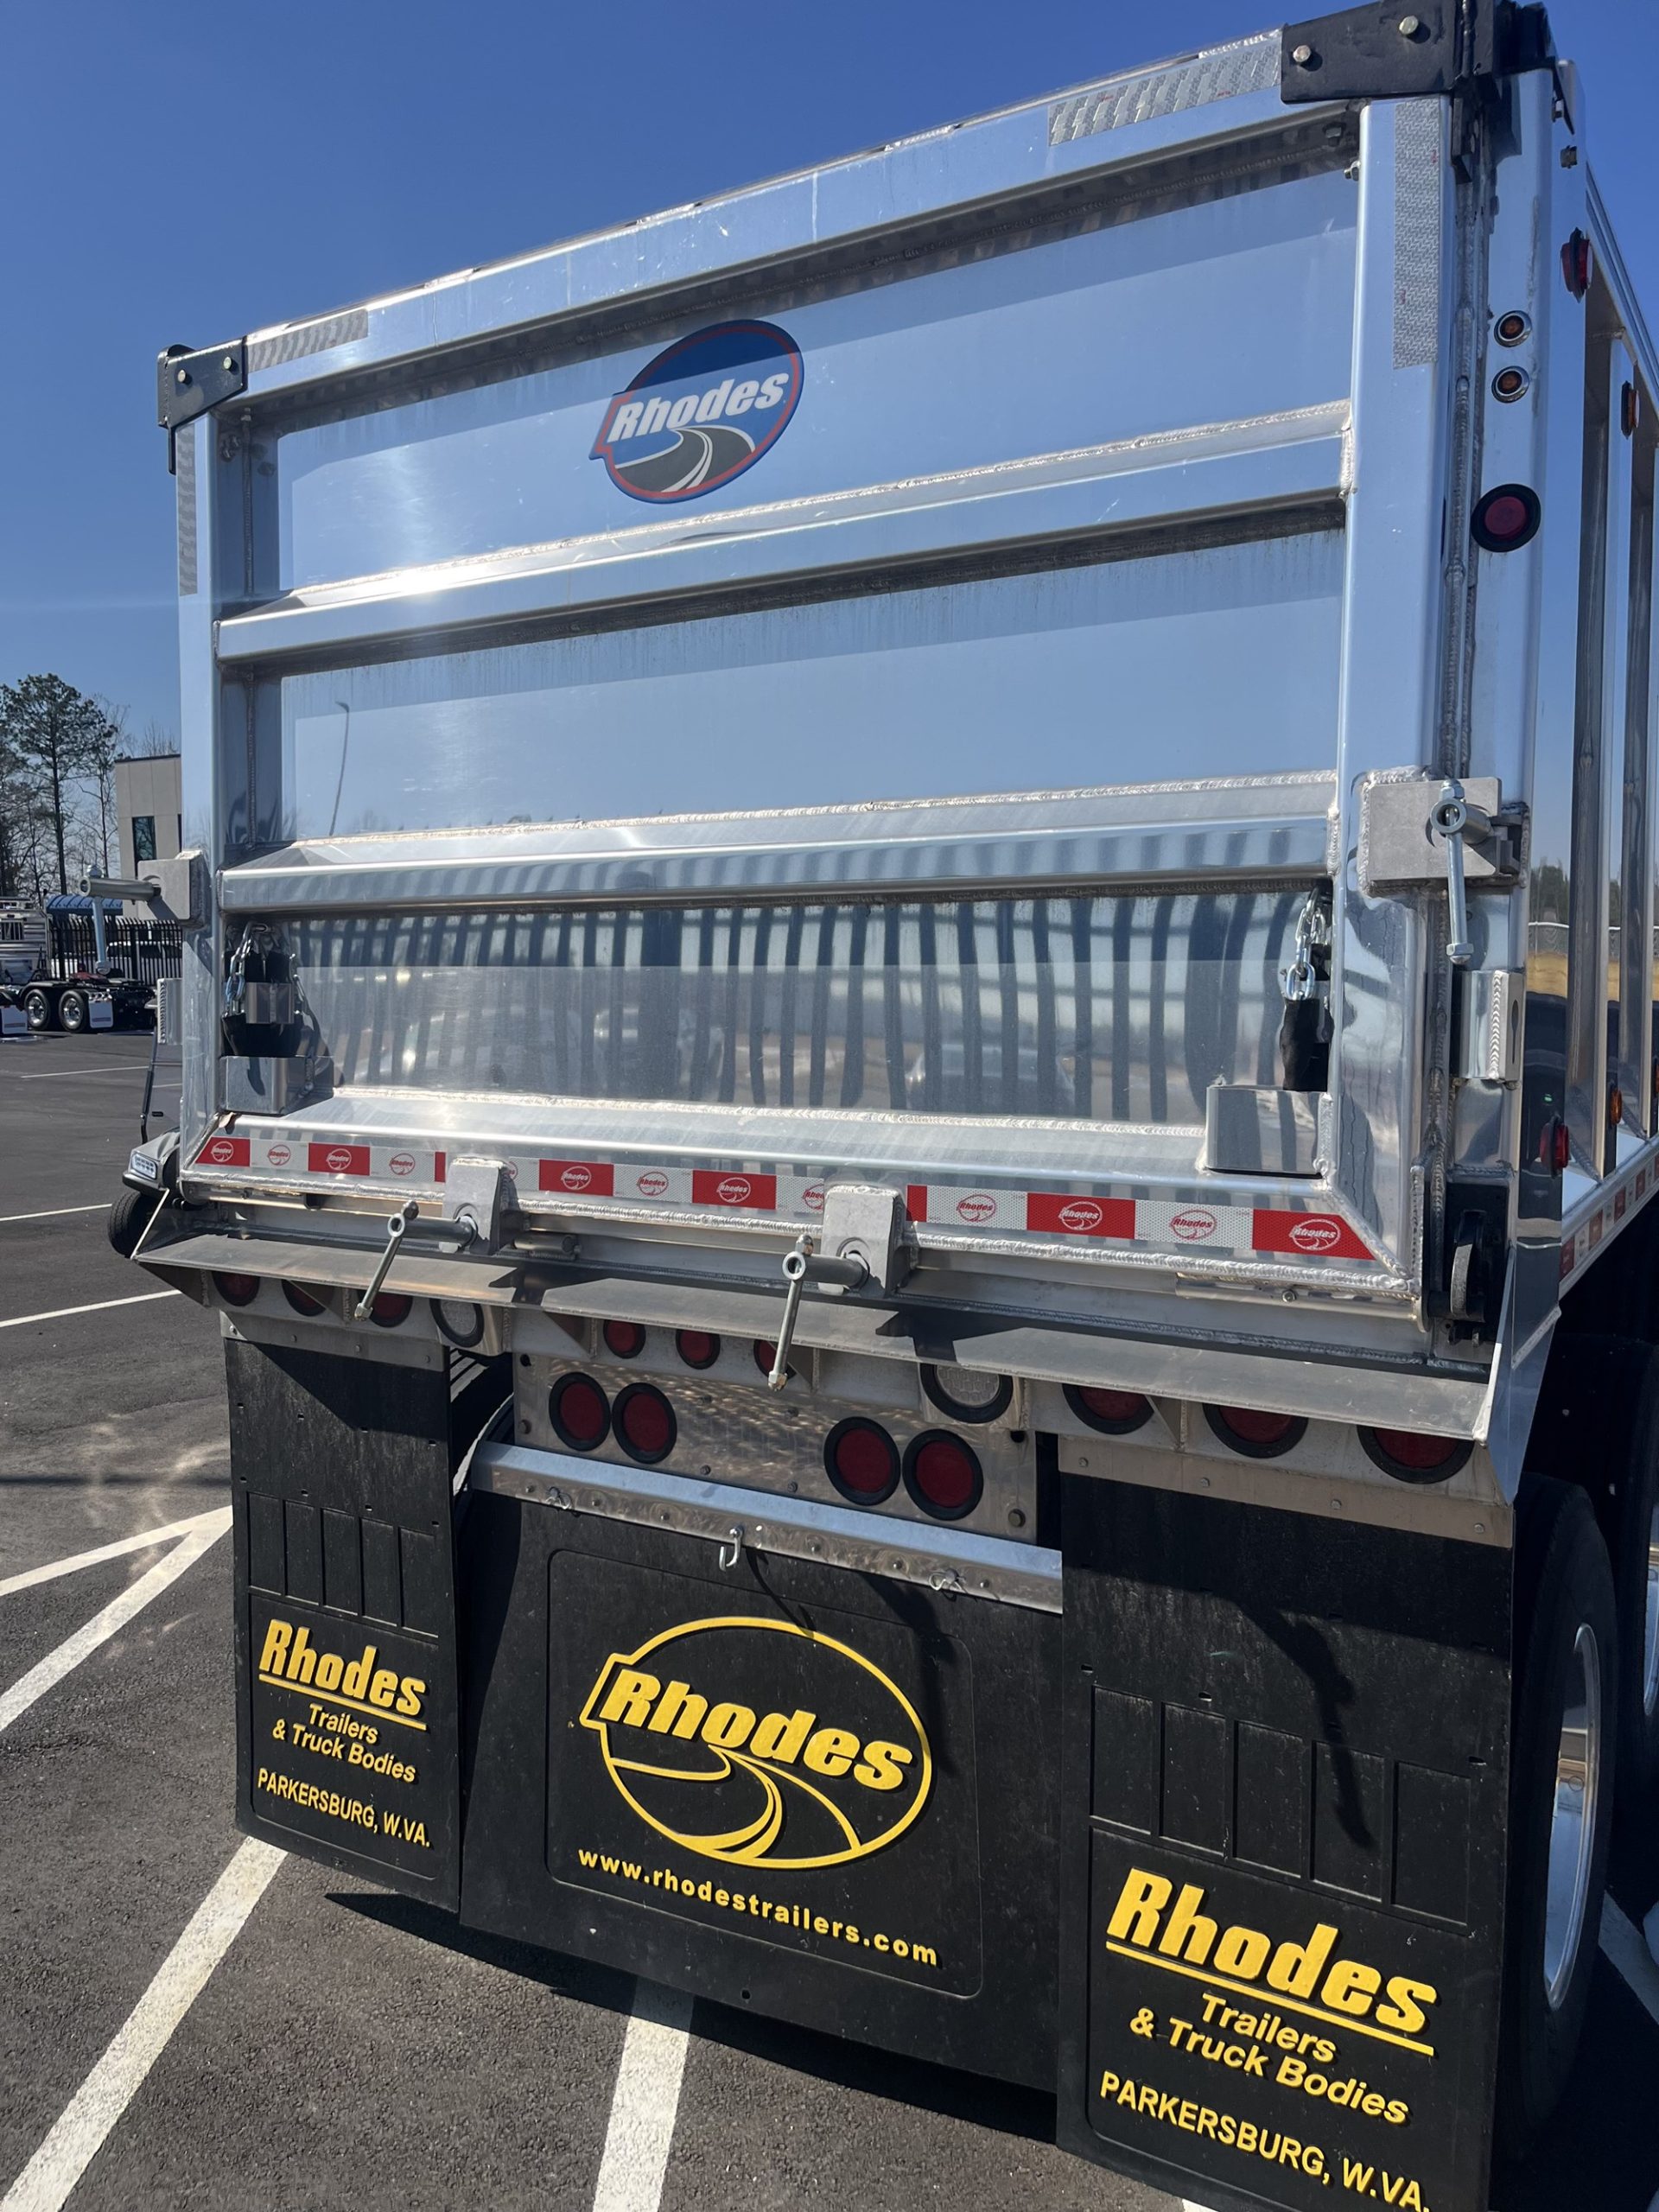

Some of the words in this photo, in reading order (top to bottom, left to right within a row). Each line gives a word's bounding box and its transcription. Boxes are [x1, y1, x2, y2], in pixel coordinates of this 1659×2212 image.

[607, 373, 790, 443] Rhodes
[640, 1177, 665, 1186] Rhodes
[719, 1182, 748, 1192] Rhodes
[960, 1202, 994, 1211] Rhodes
[1061, 1209, 1099, 1220] Rhodes
[1173, 1217, 1213, 1228] Rhodes
[1294, 1227, 1337, 1239] Rhodes
[259, 1618, 426, 1716] Rhodes
[272, 1719, 286, 1741] &
[292, 1723, 343, 1759] Truck
[347, 1742, 416, 1783] Bodies
[308, 1702, 378, 1744] Trailers
[599, 1669, 912, 1790] Rhodes
[257, 1768, 378, 1834] PARKERSBURG,
[384, 1811, 431, 1847] W.VA.
[578, 1848, 938, 1967] www.rhodestrailers.com
[1106, 1867, 1437, 2033] Rhodes
[1202, 1993, 1338, 2063] Trailers
[1129, 2007, 1154, 2038] &
[1168, 2018, 1268, 2076] Truck
[1275, 2056, 1410, 2124] Bodies
[1100, 2071, 1332, 2184] PARKERSBURG,
